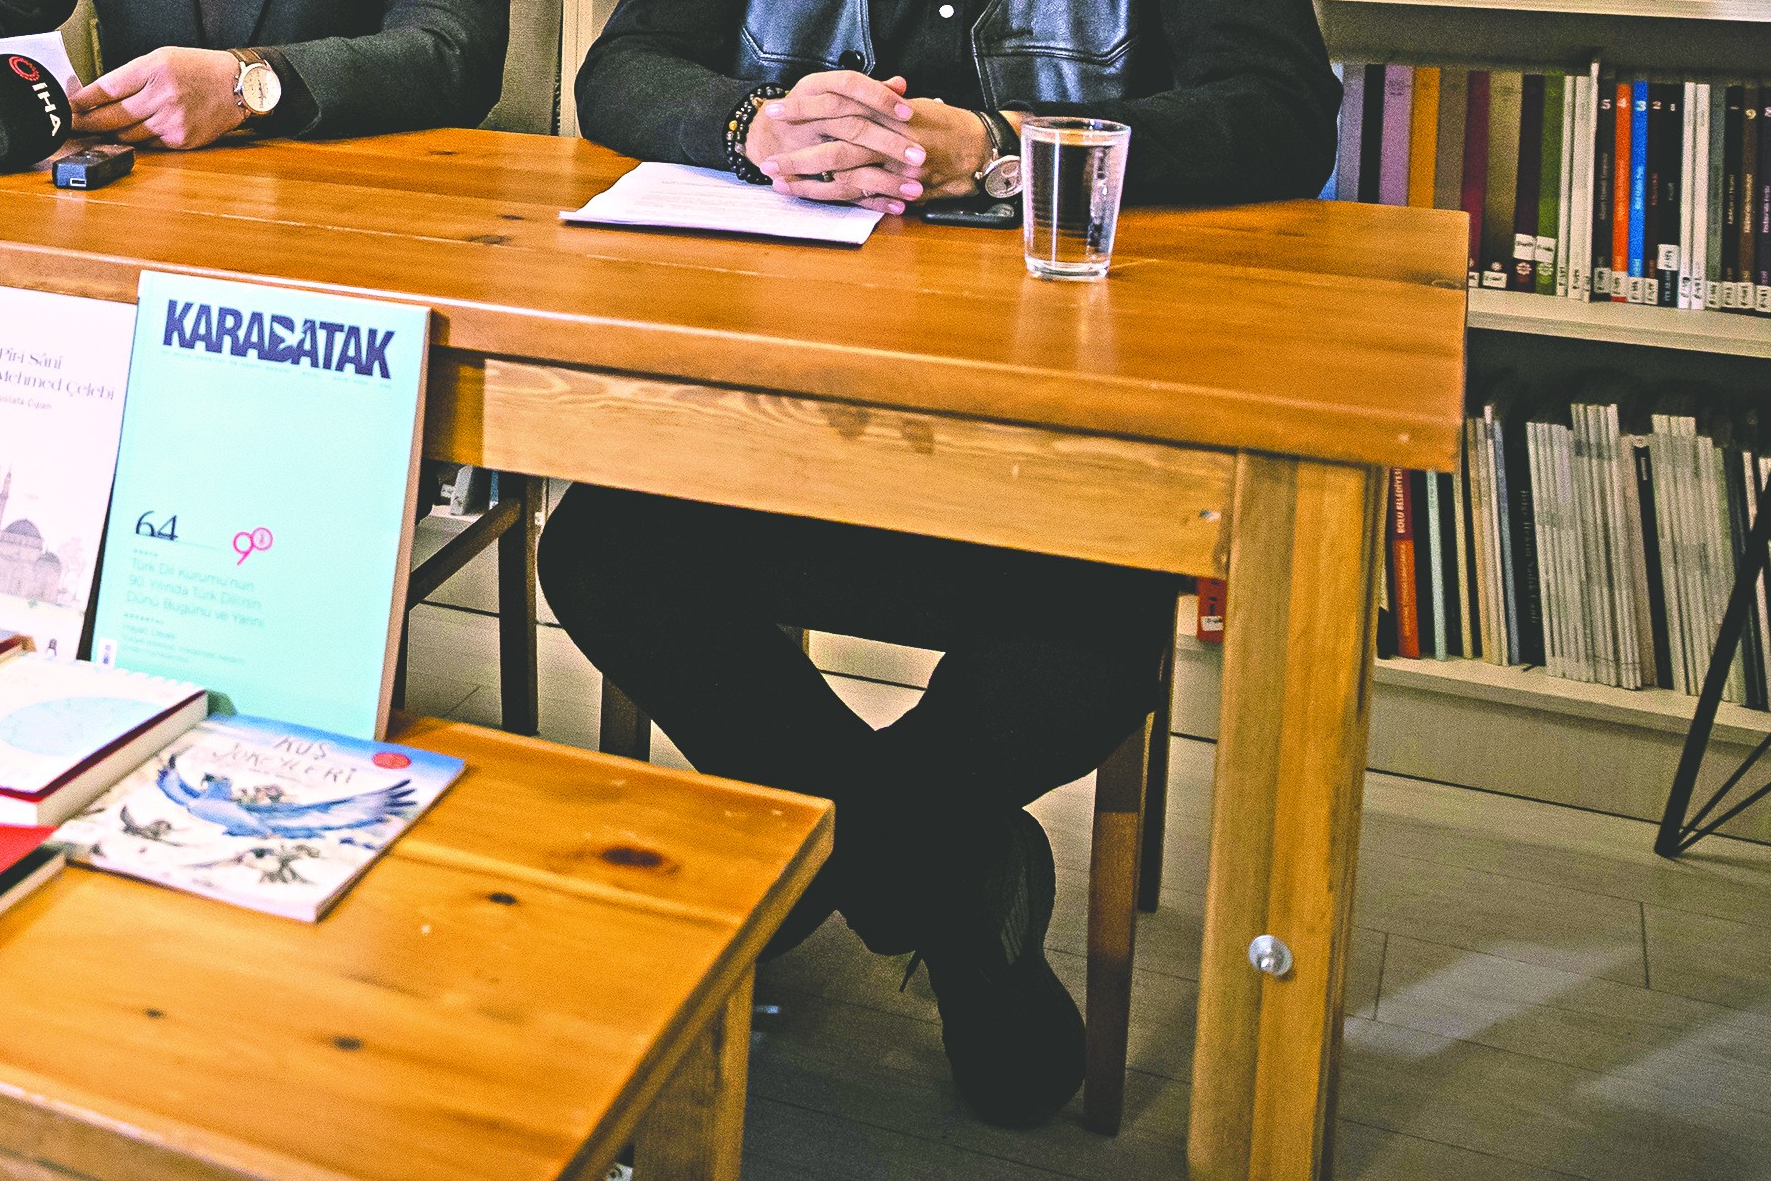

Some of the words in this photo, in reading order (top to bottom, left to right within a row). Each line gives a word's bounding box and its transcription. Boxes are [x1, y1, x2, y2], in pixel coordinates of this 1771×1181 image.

[1599, 98, 1612, 110] 5
[1616, 97, 1627, 108] 4
[1634, 99, 1647, 112] 3
[162, 299, 396, 380] KARABATAK
[135, 510, 178, 541] 64
[1396, 511, 1406, 534] BOLU
[274, 736, 328, 761] KUŞ
